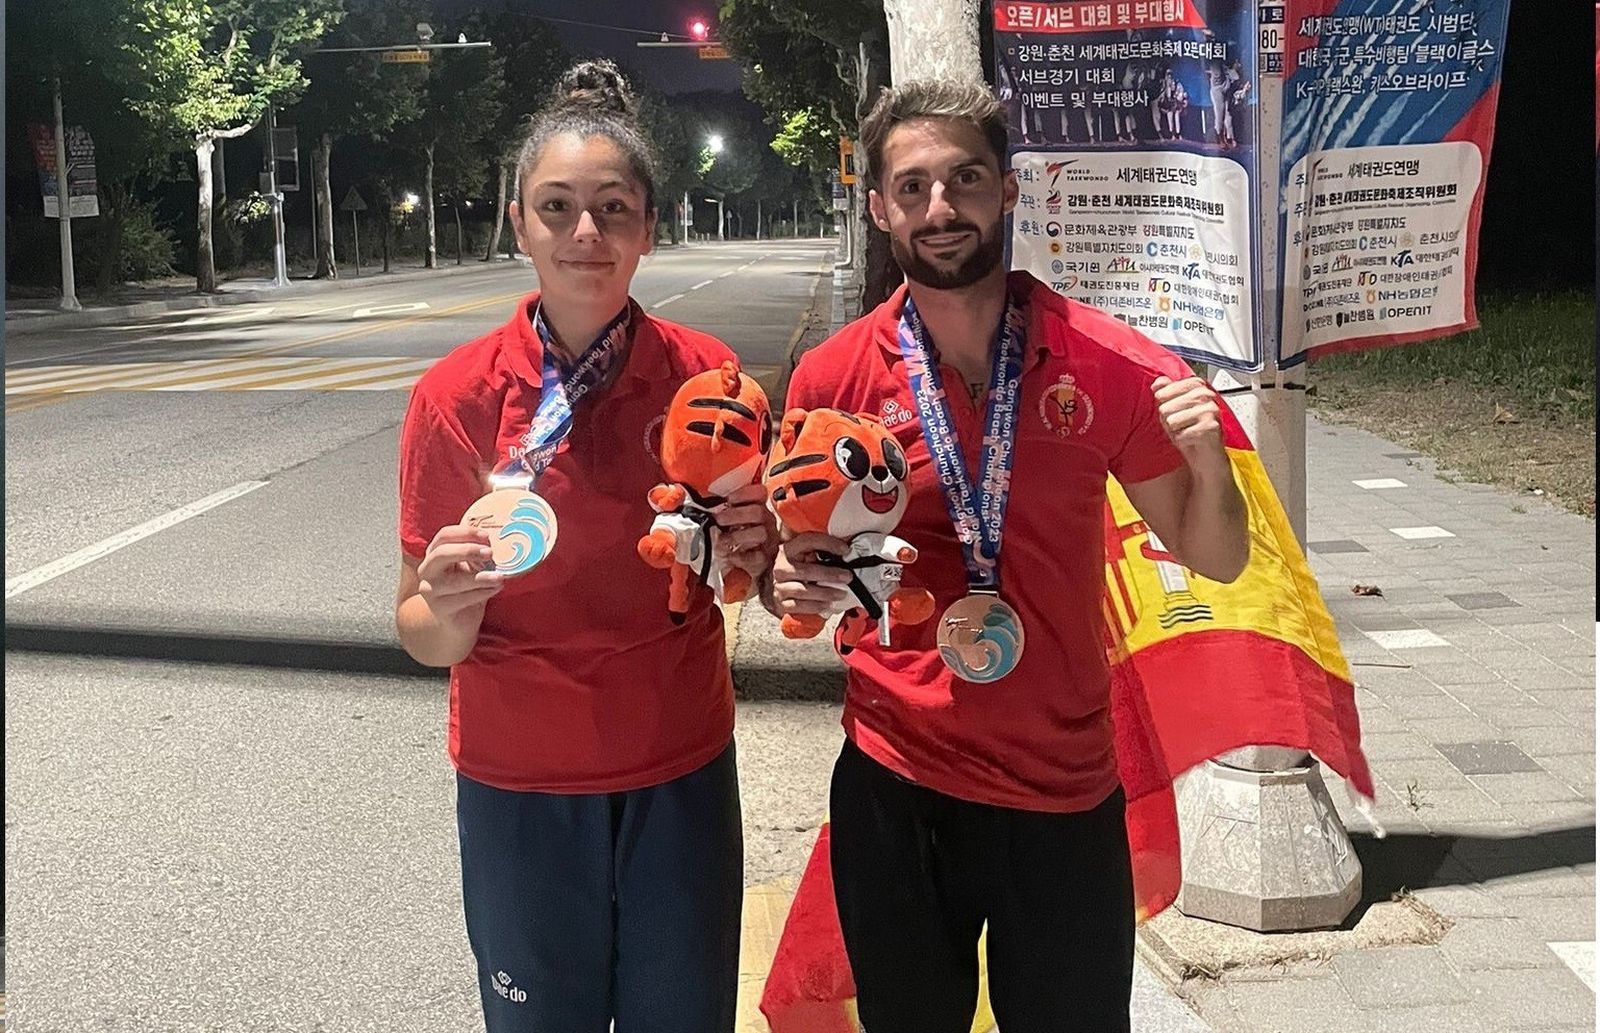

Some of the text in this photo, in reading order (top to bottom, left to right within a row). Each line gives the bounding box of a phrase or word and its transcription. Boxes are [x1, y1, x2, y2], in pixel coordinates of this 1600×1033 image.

[1007, 0, 1184, 28] 오픈/서브 대회 및 부대행사
[1262, 8, 1283, 21] 로
[1427, 12, 1475, 34] 시범단
[1018, 44, 1075, 62] 강원·춘천
[1414, 39, 1495, 64] 블랙이글스
[1019, 68, 1115, 85] 서브경기 대회
[1022, 90, 1149, 108] 이벤트 및 부대행사
[1116, 167, 1197, 186] 세계태권도연맹
[1067, 194, 1111, 207] 강원·춘천
[1143, 224, 1195, 240] 강원특별자치도
[1160, 243, 1187, 258] 춘천시
[1369, 235, 1397, 249] 춘천시
[1066, 262, 1100, 273] 국기원
[1391, 250, 1414, 268] KTA
[1182, 263, 1201, 280] KTA
[1080, 280, 1139, 291] 태권도진흥재단
[995, 337, 1010, 401] Taekwondo
[931, 398, 950, 436] Beach
[991, 404, 1006, 444] Beach
[916, 389, 973, 545] Gangwon Chuncheon 2023
[989, 379, 1018, 543] Gangwon Chuncheon 2023
[944, 436, 971, 506] Taekwondo
